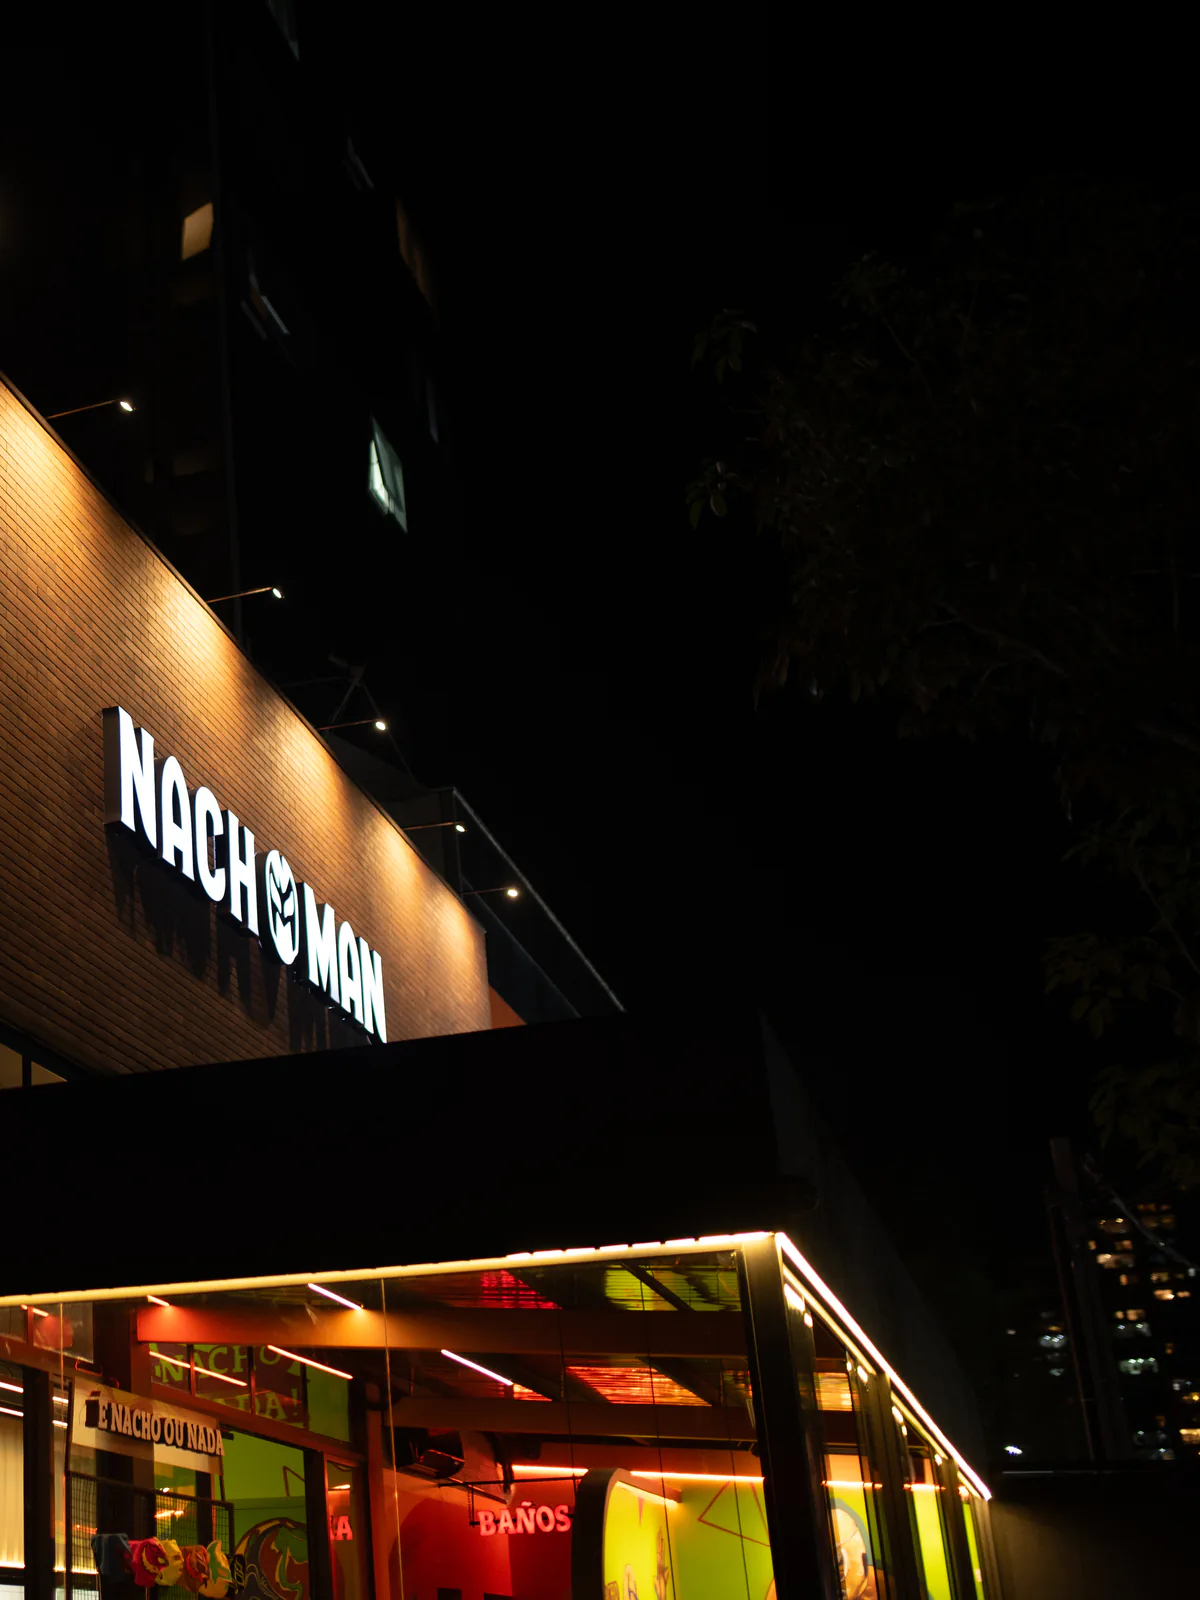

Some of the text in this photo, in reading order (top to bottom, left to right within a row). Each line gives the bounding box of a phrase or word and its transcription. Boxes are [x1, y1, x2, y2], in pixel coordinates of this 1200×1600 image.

[303, 882, 388, 1044] MAN
[110, 1402, 161, 1442] NACHO
[164, 1416, 184, 1447] OU
[187, 1422, 225, 1456] NADA
[477, 1501, 572, 1537] BAÑOS
